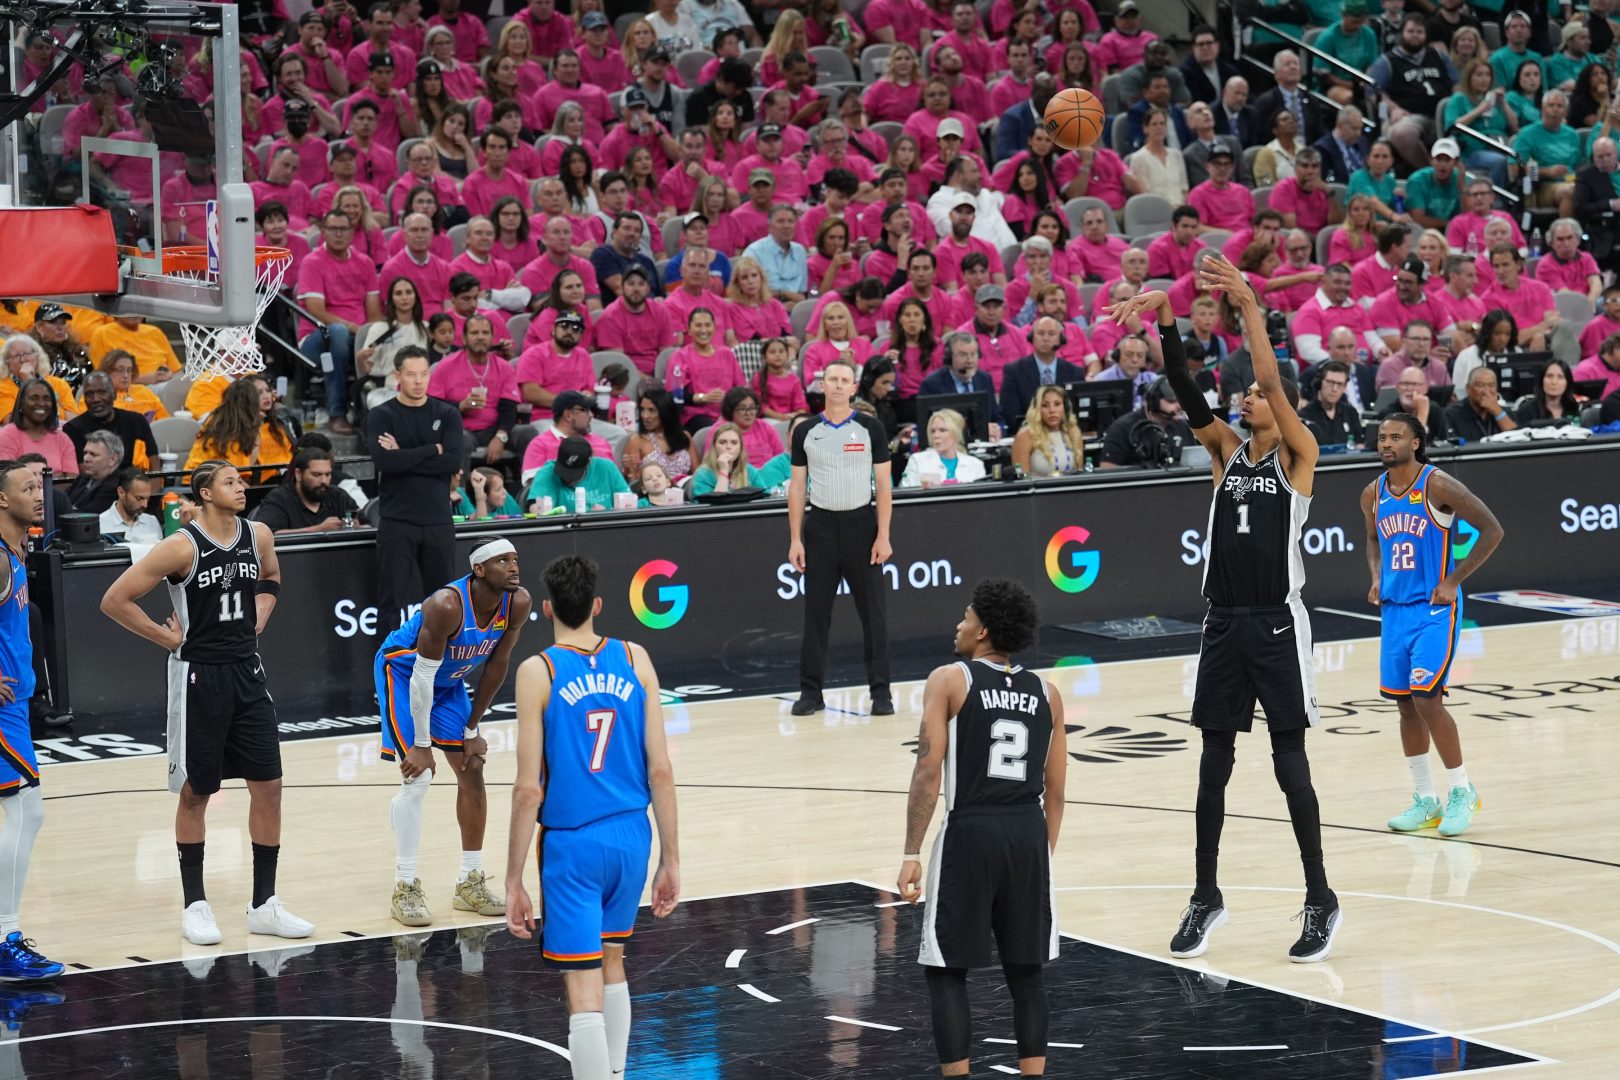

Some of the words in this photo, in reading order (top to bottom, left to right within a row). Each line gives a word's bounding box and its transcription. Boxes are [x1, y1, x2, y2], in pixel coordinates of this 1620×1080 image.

[1224, 475, 1277, 495] SPURS
[1236, 504, 1250, 534] 1
[1378, 513, 1428, 539] THUNDER
[1303, 526, 1355, 555] on.
[1045, 525, 1101, 593] G
[1391, 542, 1416, 570] 22
[197, 562, 258, 589] SPURS
[908, 559, 962, 591] on.
[219, 591, 244, 622] 11
[629, 559, 689, 630] G
[450, 664, 473, 679] 2
[558, 672, 635, 706] HOLMGREN
[980, 689, 1039, 715] HARPER
[586, 708, 617, 774] 7
[986, 718, 1030, 782] 2
